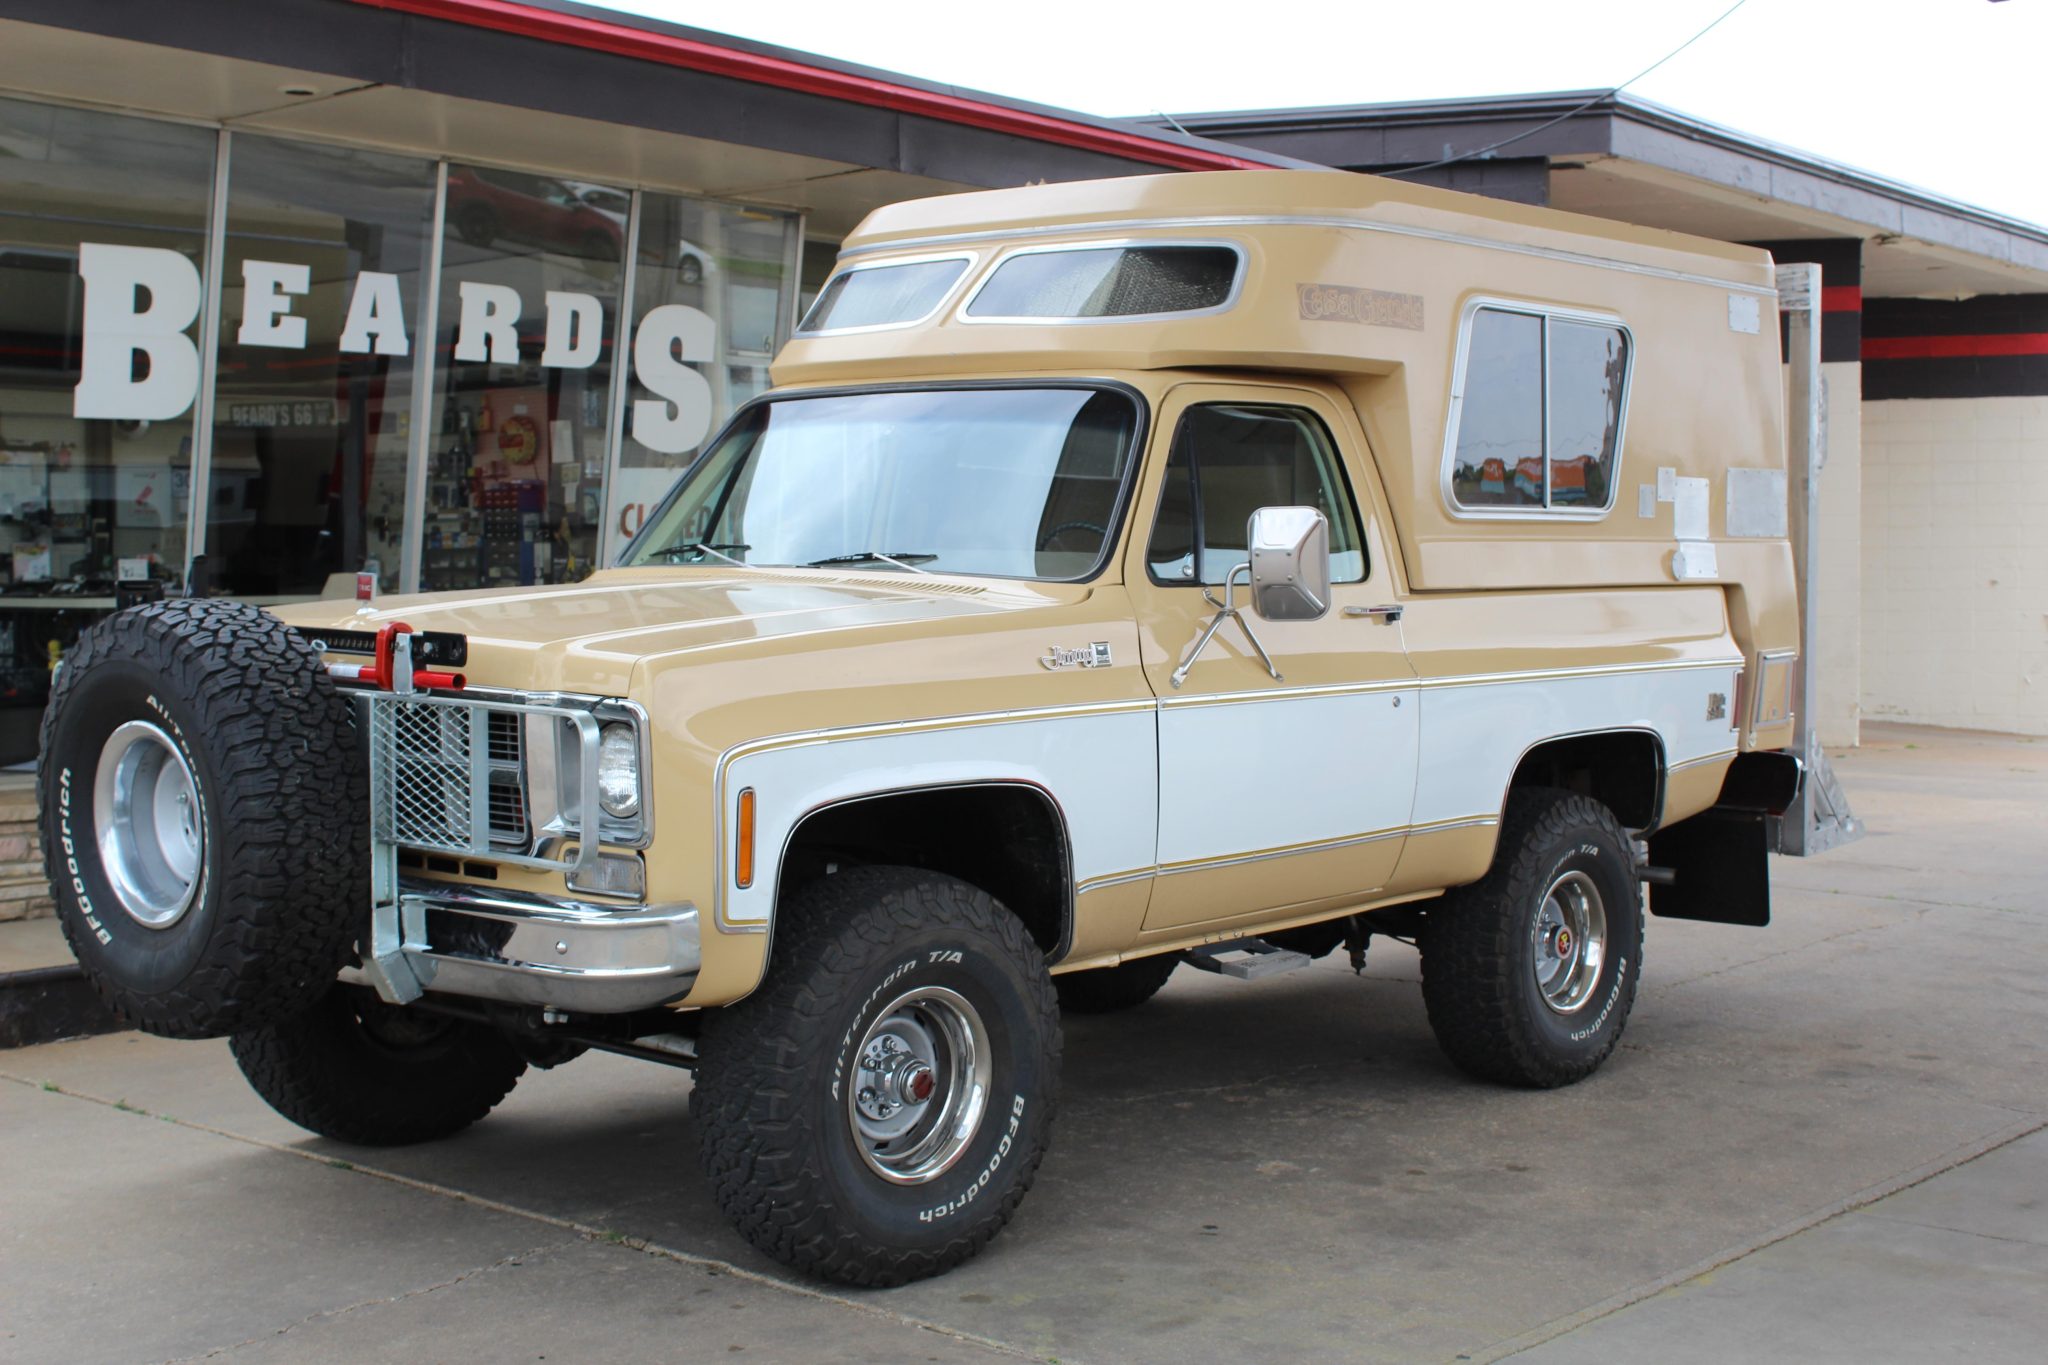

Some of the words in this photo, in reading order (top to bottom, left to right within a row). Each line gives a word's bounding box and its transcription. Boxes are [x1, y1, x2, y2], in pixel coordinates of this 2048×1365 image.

[293, 403, 313, 426] 66
[58, 766, 113, 946] BFGoodrich
[1579, 844, 1599, 857] T/A
[831, 959, 917, 1101] All-Terrain
[928, 949, 963, 964] T/A
[1571, 956, 1627, 1042] BFGoodrich
[919, 1093, 1025, 1224] BFGoodrich
